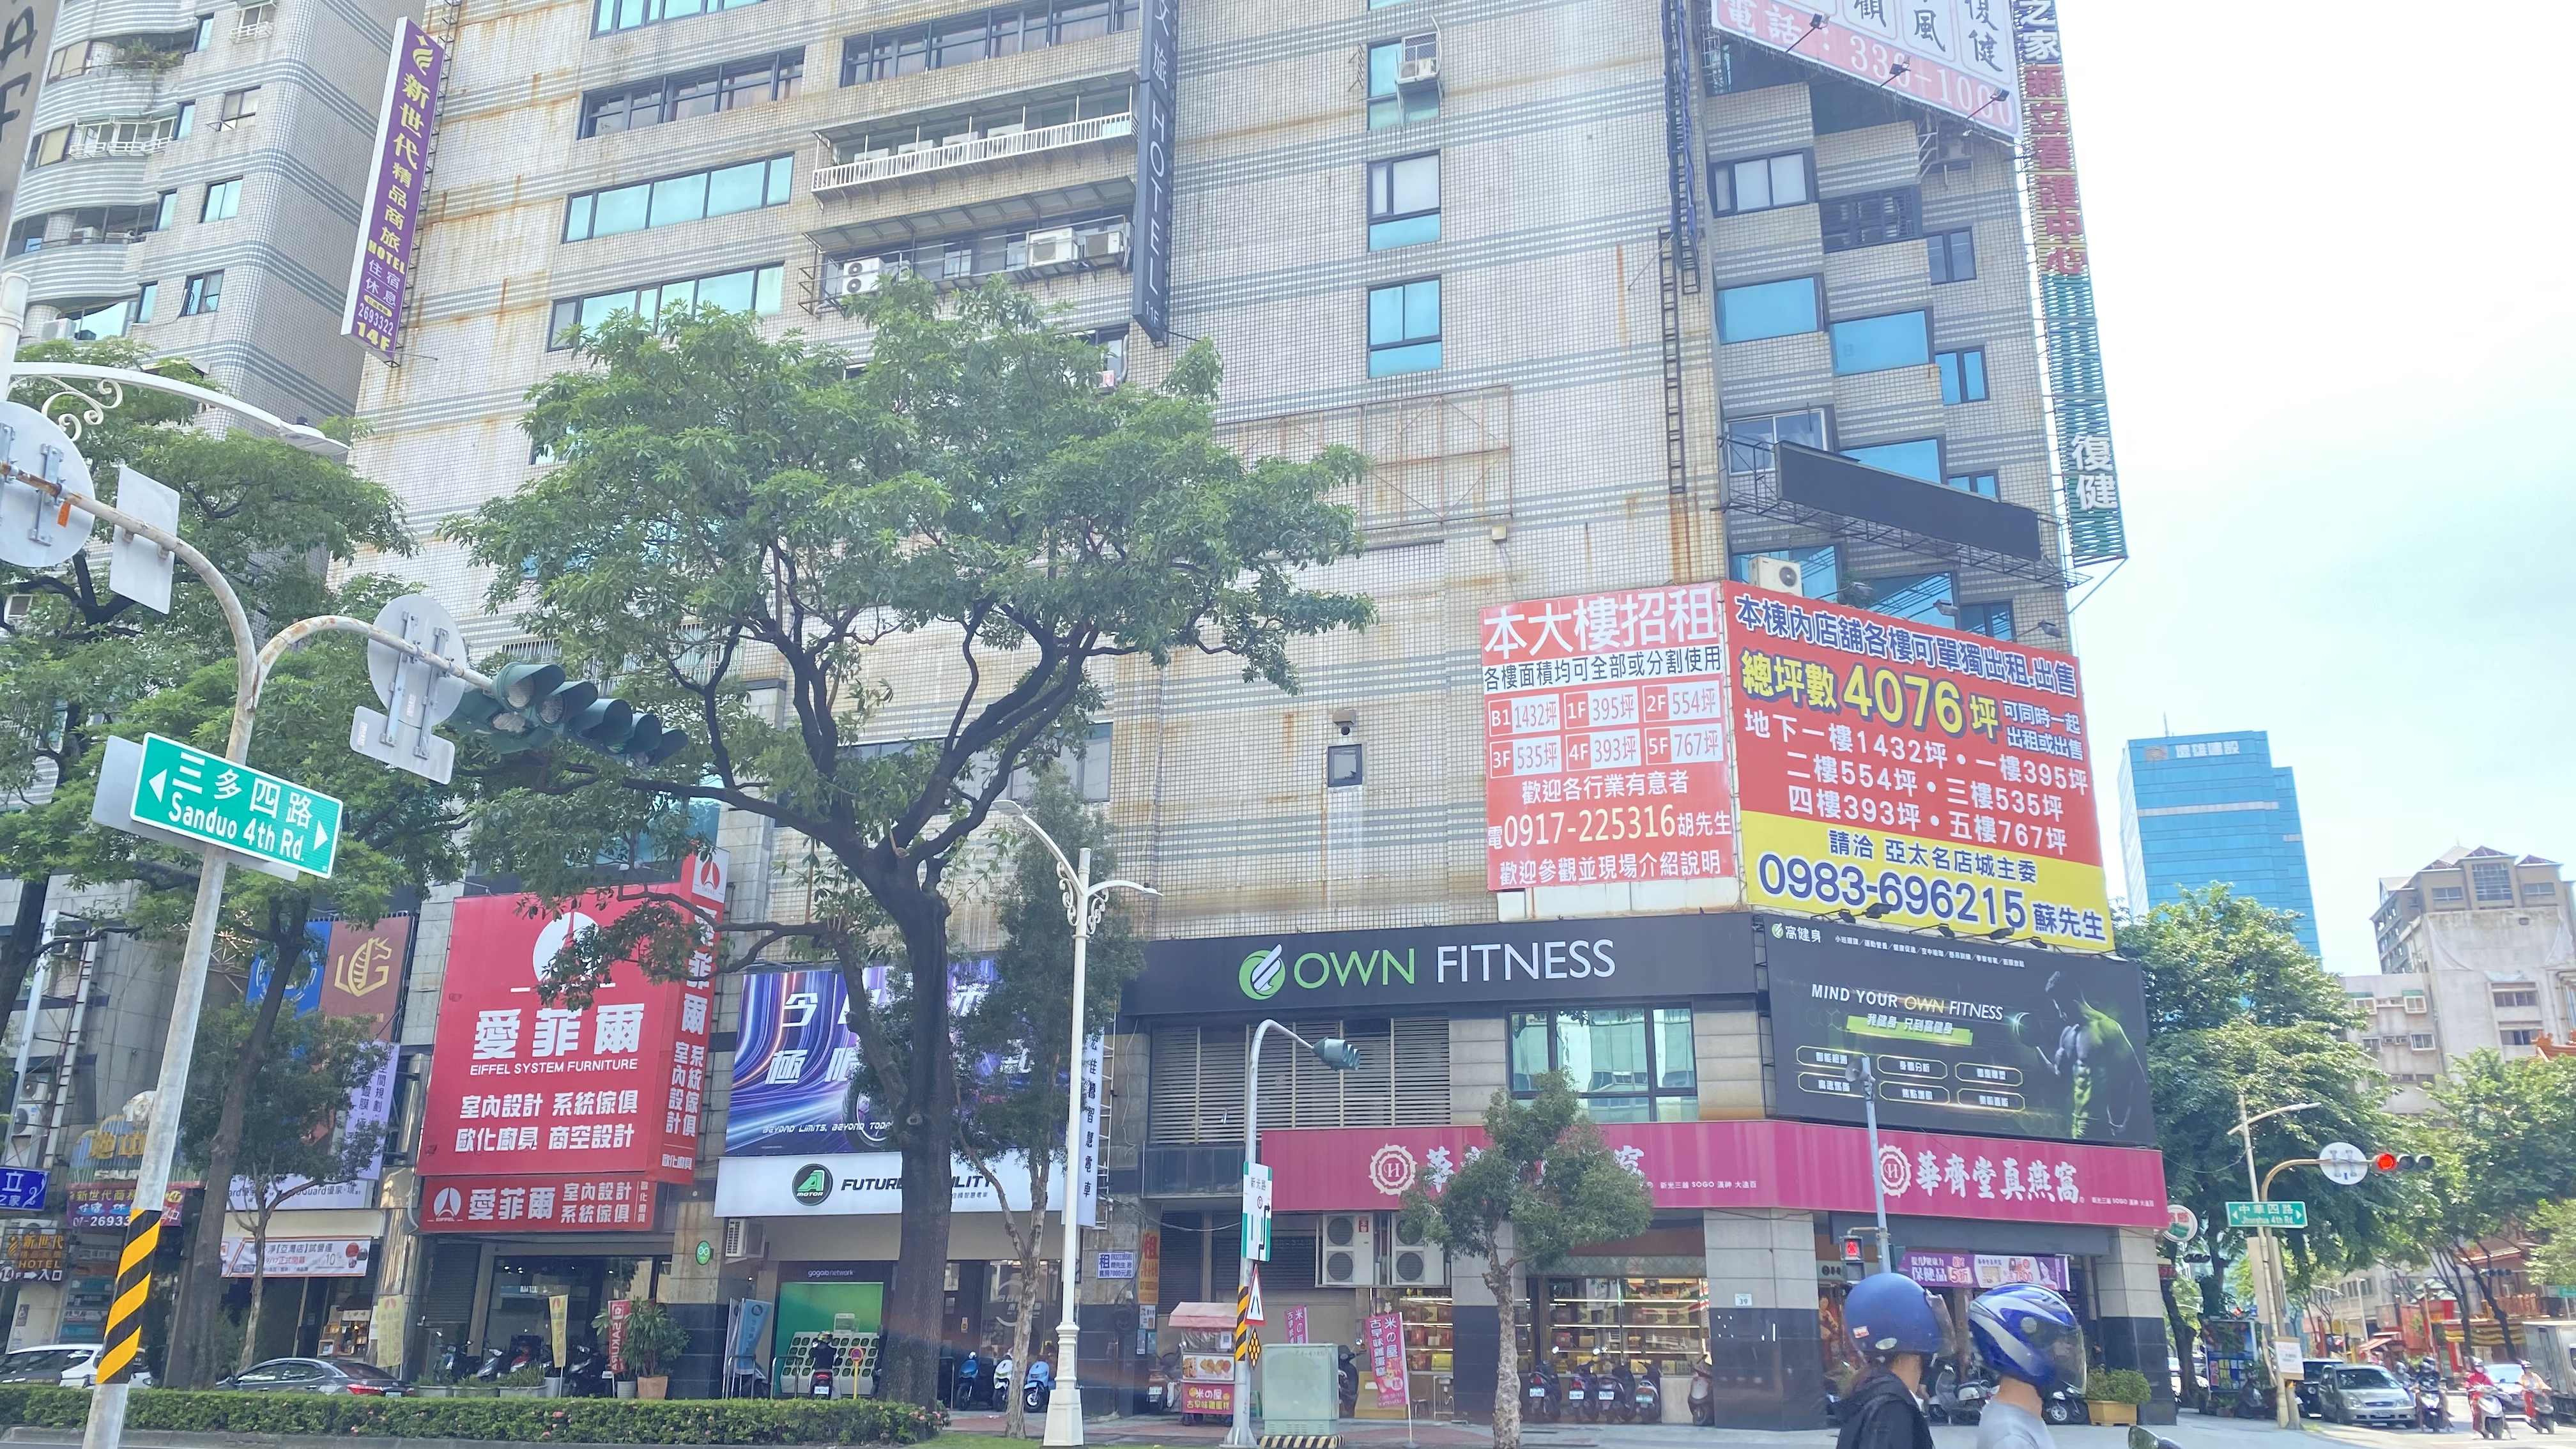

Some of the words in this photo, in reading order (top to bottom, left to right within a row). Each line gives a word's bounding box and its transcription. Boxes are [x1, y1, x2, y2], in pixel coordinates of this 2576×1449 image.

[380, 73, 431, 252] 新世代精品商旅
[1149, 100, 1165, 295] HOTEL
[368, 240, 405, 275] HOTEL
[369, 259, 401, 290] 住宿
[365, 277, 396, 307] 休息
[358, 303, 394, 337] 2693322
[1146, 300, 1160, 324] 11F
[357, 321, 390, 351] 14F
[2071, 434, 2118, 510] 復健
[1483, 588, 1717, 659] 本大樓招租
[1484, 646, 1721, 692] 各樓面積均可全部或分割使用
[1567, 702, 1586, 719] 1F
[1593, 694, 1634, 721] 395坪
[1647, 694, 1666, 712] 2F
[1673, 687, 1715, 715] 554坪
[1741, 651, 1837, 710] 總坪數
[1844, 664, 1963, 734] 4076
[1492, 710, 1511, 727] B1
[1514, 701, 1556, 728] 1432坪
[2002, 700, 2082, 735] 可同時一起
[1493, 751, 1511, 768] 3F
[1517, 741, 1558, 769] 535坪
[1569, 744, 1588, 761] 4F
[1595, 735, 1636, 762] 393坪
[1649, 737, 1667, 755] 5F
[1675, 730, 1718, 758] 767坪
[2006, 726, 2083, 762] 出租或出售
[172, 751, 313, 829] 三多四路
[1521, 769, 1689, 805] 歡迎各行業有意者
[169, 792, 237, 839] Sanduo
[243, 818, 275, 852] 4th
[279, 828, 305, 862] Rd.
[1504, 804, 1675, 847] 0917-225316
[1500, 850, 1721, 887] 歡迎參觀並現場介紹說明
[1828, 829, 1874, 859] 請洽
[1885, 837, 2037, 884] 亞太名店城主委
[1758, 852, 2025, 930] 0983-696215
[2033, 902, 2106, 941] 蘇先生
[1294, 948, 1415, 989] OWN
[1438, 939, 1616, 983] FITNESS
[1812, 984, 1850, 1001] MIND
[1856, 990, 1897, 1008] YOUR
[1904, 995, 1945, 1013] OWN
[1950, 1000, 2004, 1020] FITNESS
[473, 1003, 644, 1060] 愛菲爾
[470, 1062, 510, 1075] EIFFEL
[514, 1061, 564, 1074] SYSTEM
[567, 1059, 638, 1072] FURNITURE
[460, 1093, 543, 1119] 室內設計
[551, 1089, 638, 1117] 系統傢俱
[665, 1041, 687, 1135] 室內設計
[685, 1046, 704, 1137] 系統傢俱
[454, 1126, 539, 1153] 歐化廚具
[548, 1123, 634, 1150] 商空設計
[763, 1124, 795, 1133] BEYOND
[832, 1122, 864, 1131] BEYOND
[563, 1182, 631, 1201] 室內設計
[1251, 1177, 1266, 1191] 新光路
[468, 1187, 555, 1220] 愛菲爾
[560, 1204, 629, 1223] 系統傢俱
[2239, 1204, 2294, 1215] 中華四路
[2242, 1216, 2269, 1225] Jhonghua
[2271, 1216, 2283, 1224] 4th
[22, 1233, 63, 1250] 新世代
[19, 1259, 61, 1269] HOTEL
[38, 1269, 63, 1282] 入口
[1100, 1254, 1110, 1269] 租
[1384, 1317, 1398, 1358] 米の屋
[1195, 1388, 1222, 1400] 米の屋
